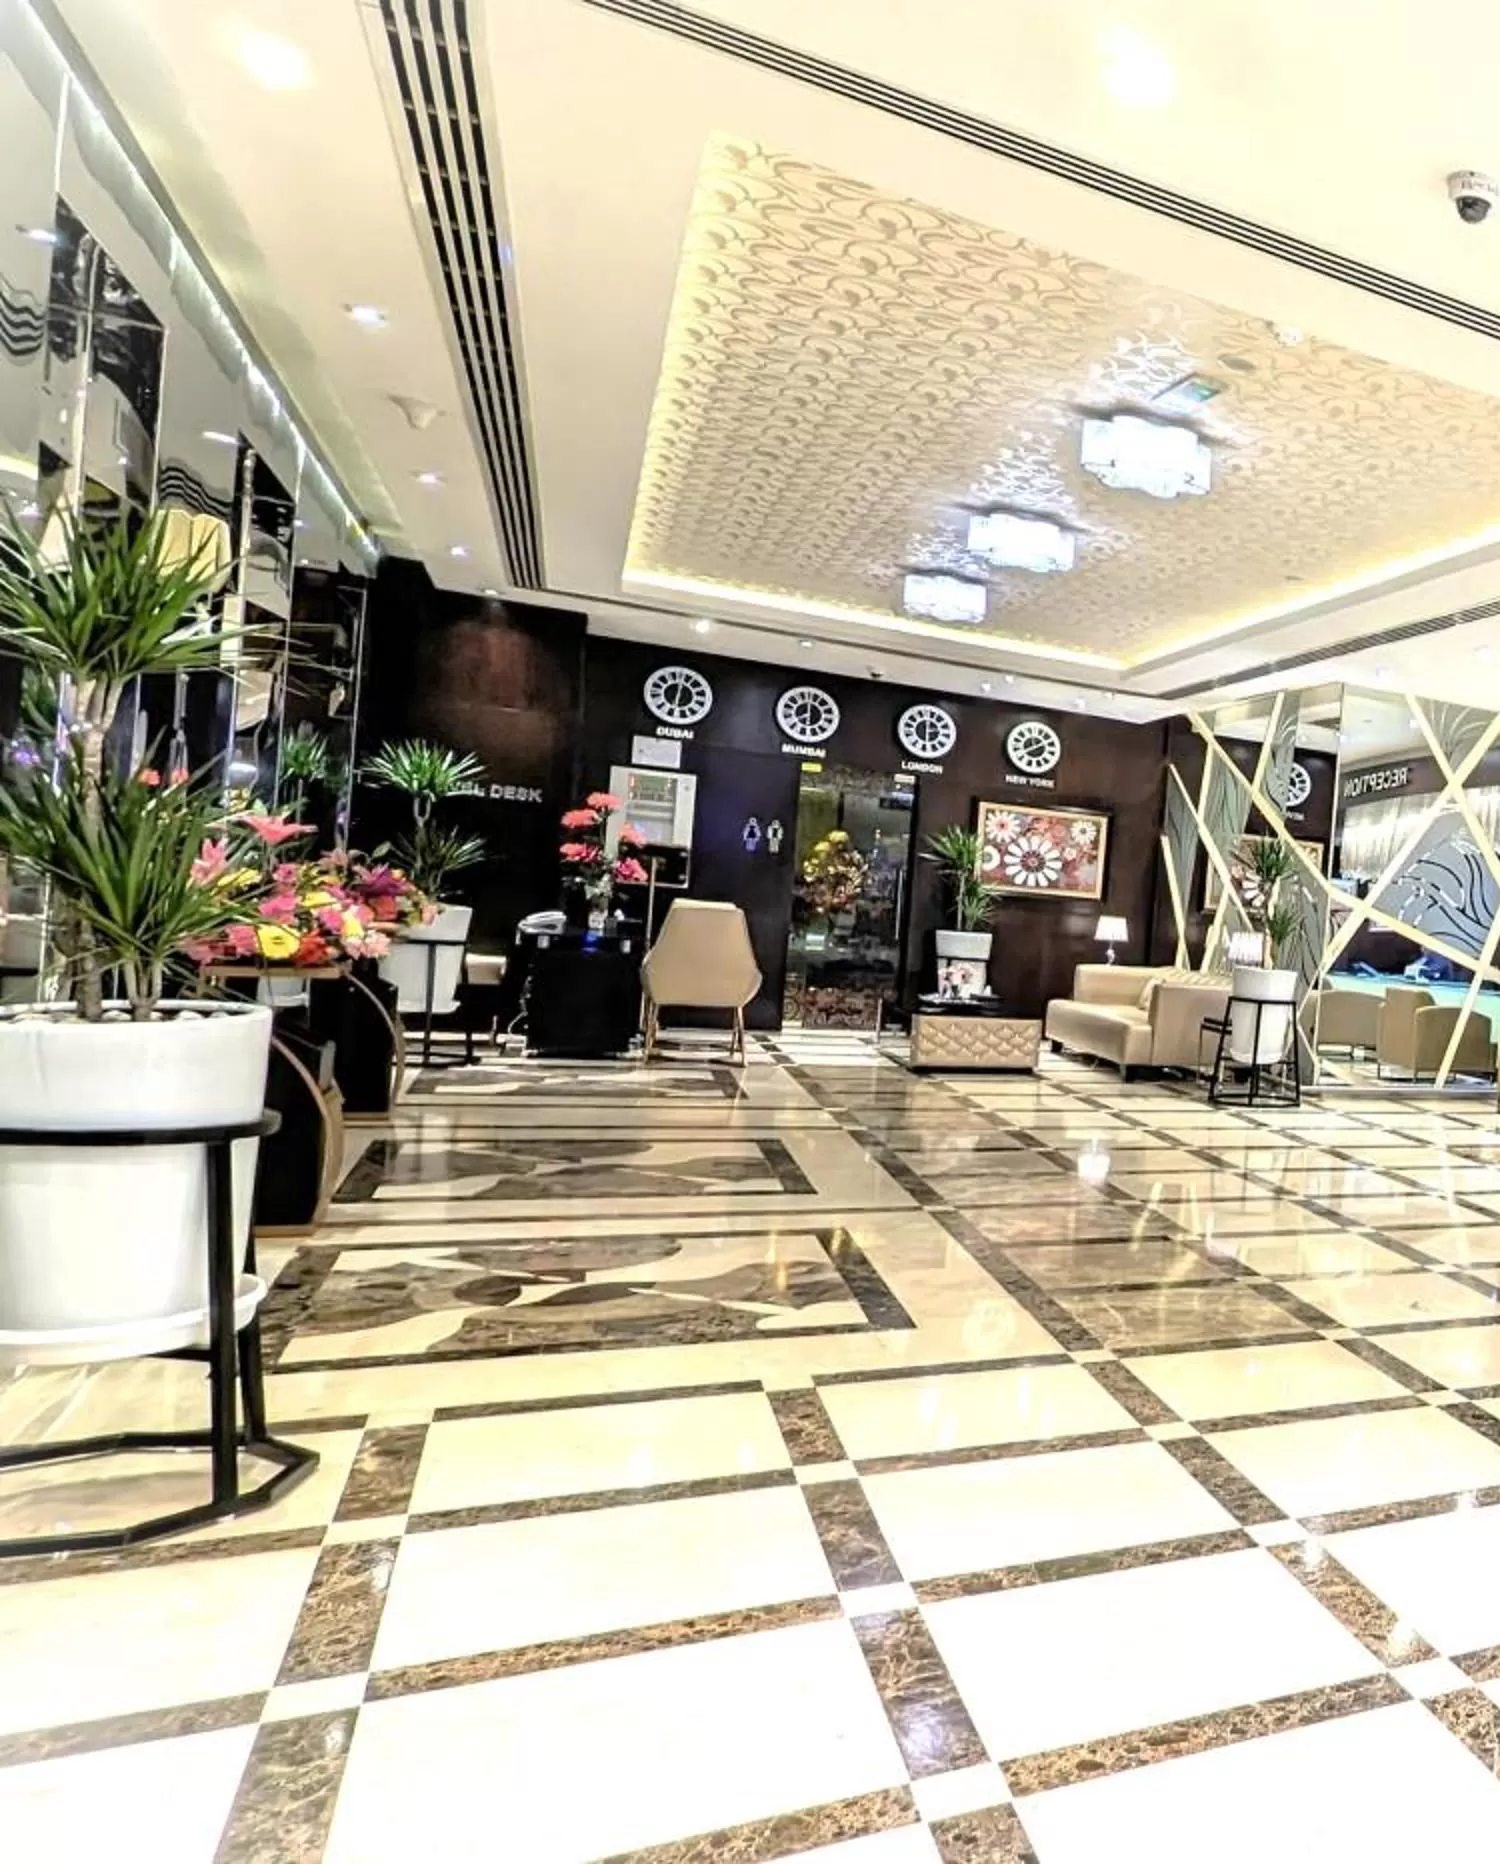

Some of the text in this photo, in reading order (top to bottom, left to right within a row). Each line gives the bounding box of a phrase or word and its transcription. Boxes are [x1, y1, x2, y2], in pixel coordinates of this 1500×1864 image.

[656, 726, 694, 739] DUBAI
[781, 743, 827, 758] MUMBAI
[901, 760, 943, 774] LONDON
[1005, 774, 1055, 788] NEW YORK
[490, 783, 543, 803] DESK
